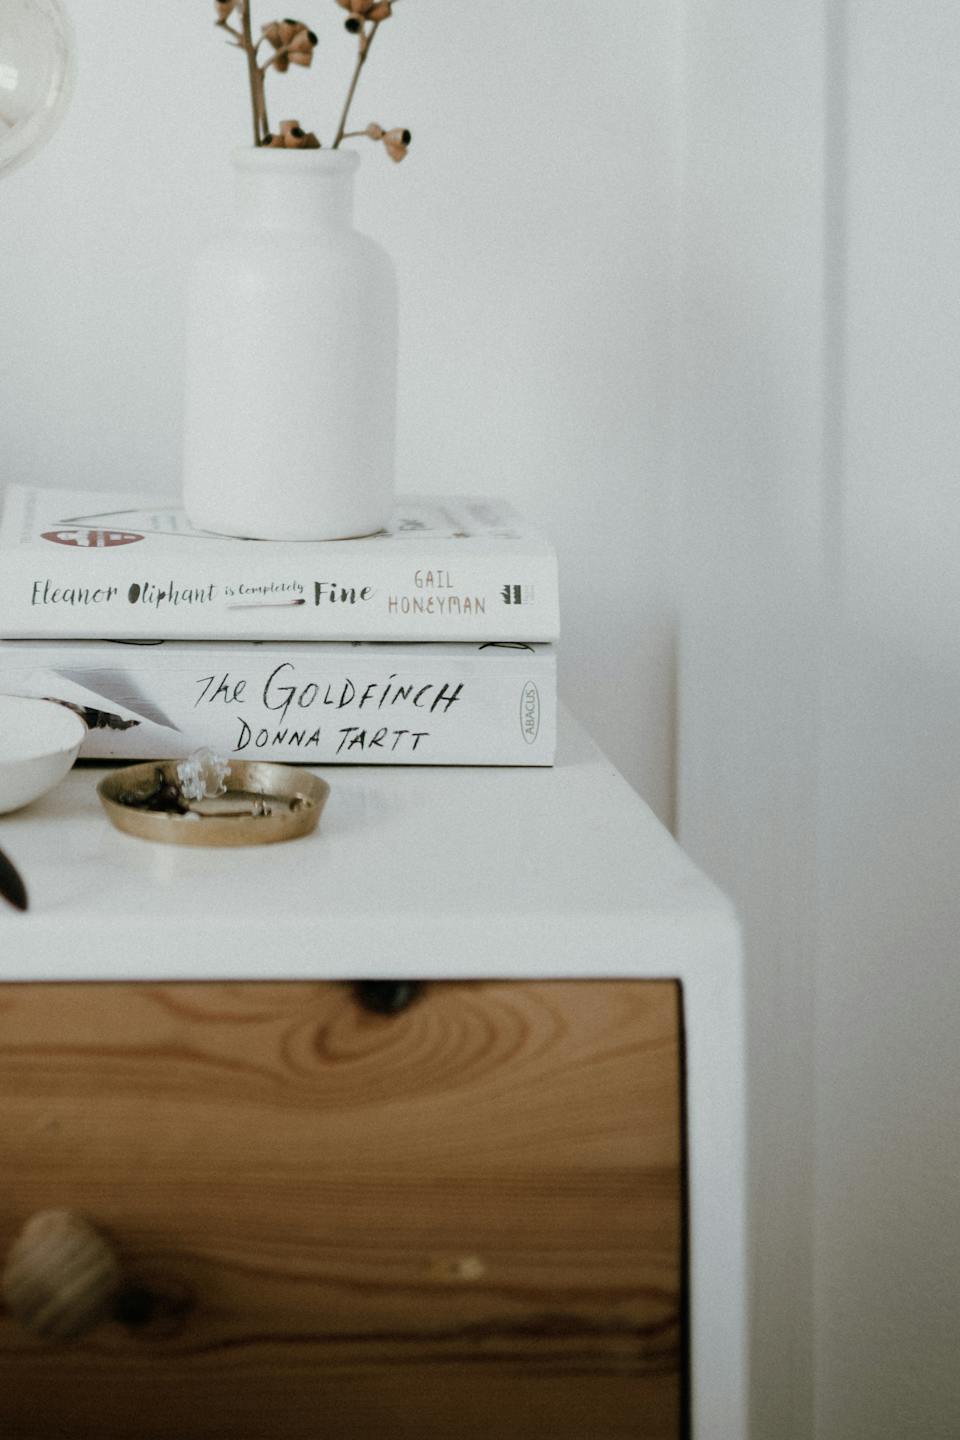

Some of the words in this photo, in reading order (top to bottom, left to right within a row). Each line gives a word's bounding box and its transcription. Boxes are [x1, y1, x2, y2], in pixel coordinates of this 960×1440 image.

[414, 570, 453, 588] GAIL
[31, 579, 118, 606] Eleanor
[128, 580, 216, 608] Oliphant
[225, 586, 234, 596] is
[314, 580, 375, 606] Fine
[388, 596, 486, 614] HONEYMAN
[195, 673, 247, 708] The
[525, 689, 536, 735] ABACUS
[336, 726, 430, 754] TARTT
